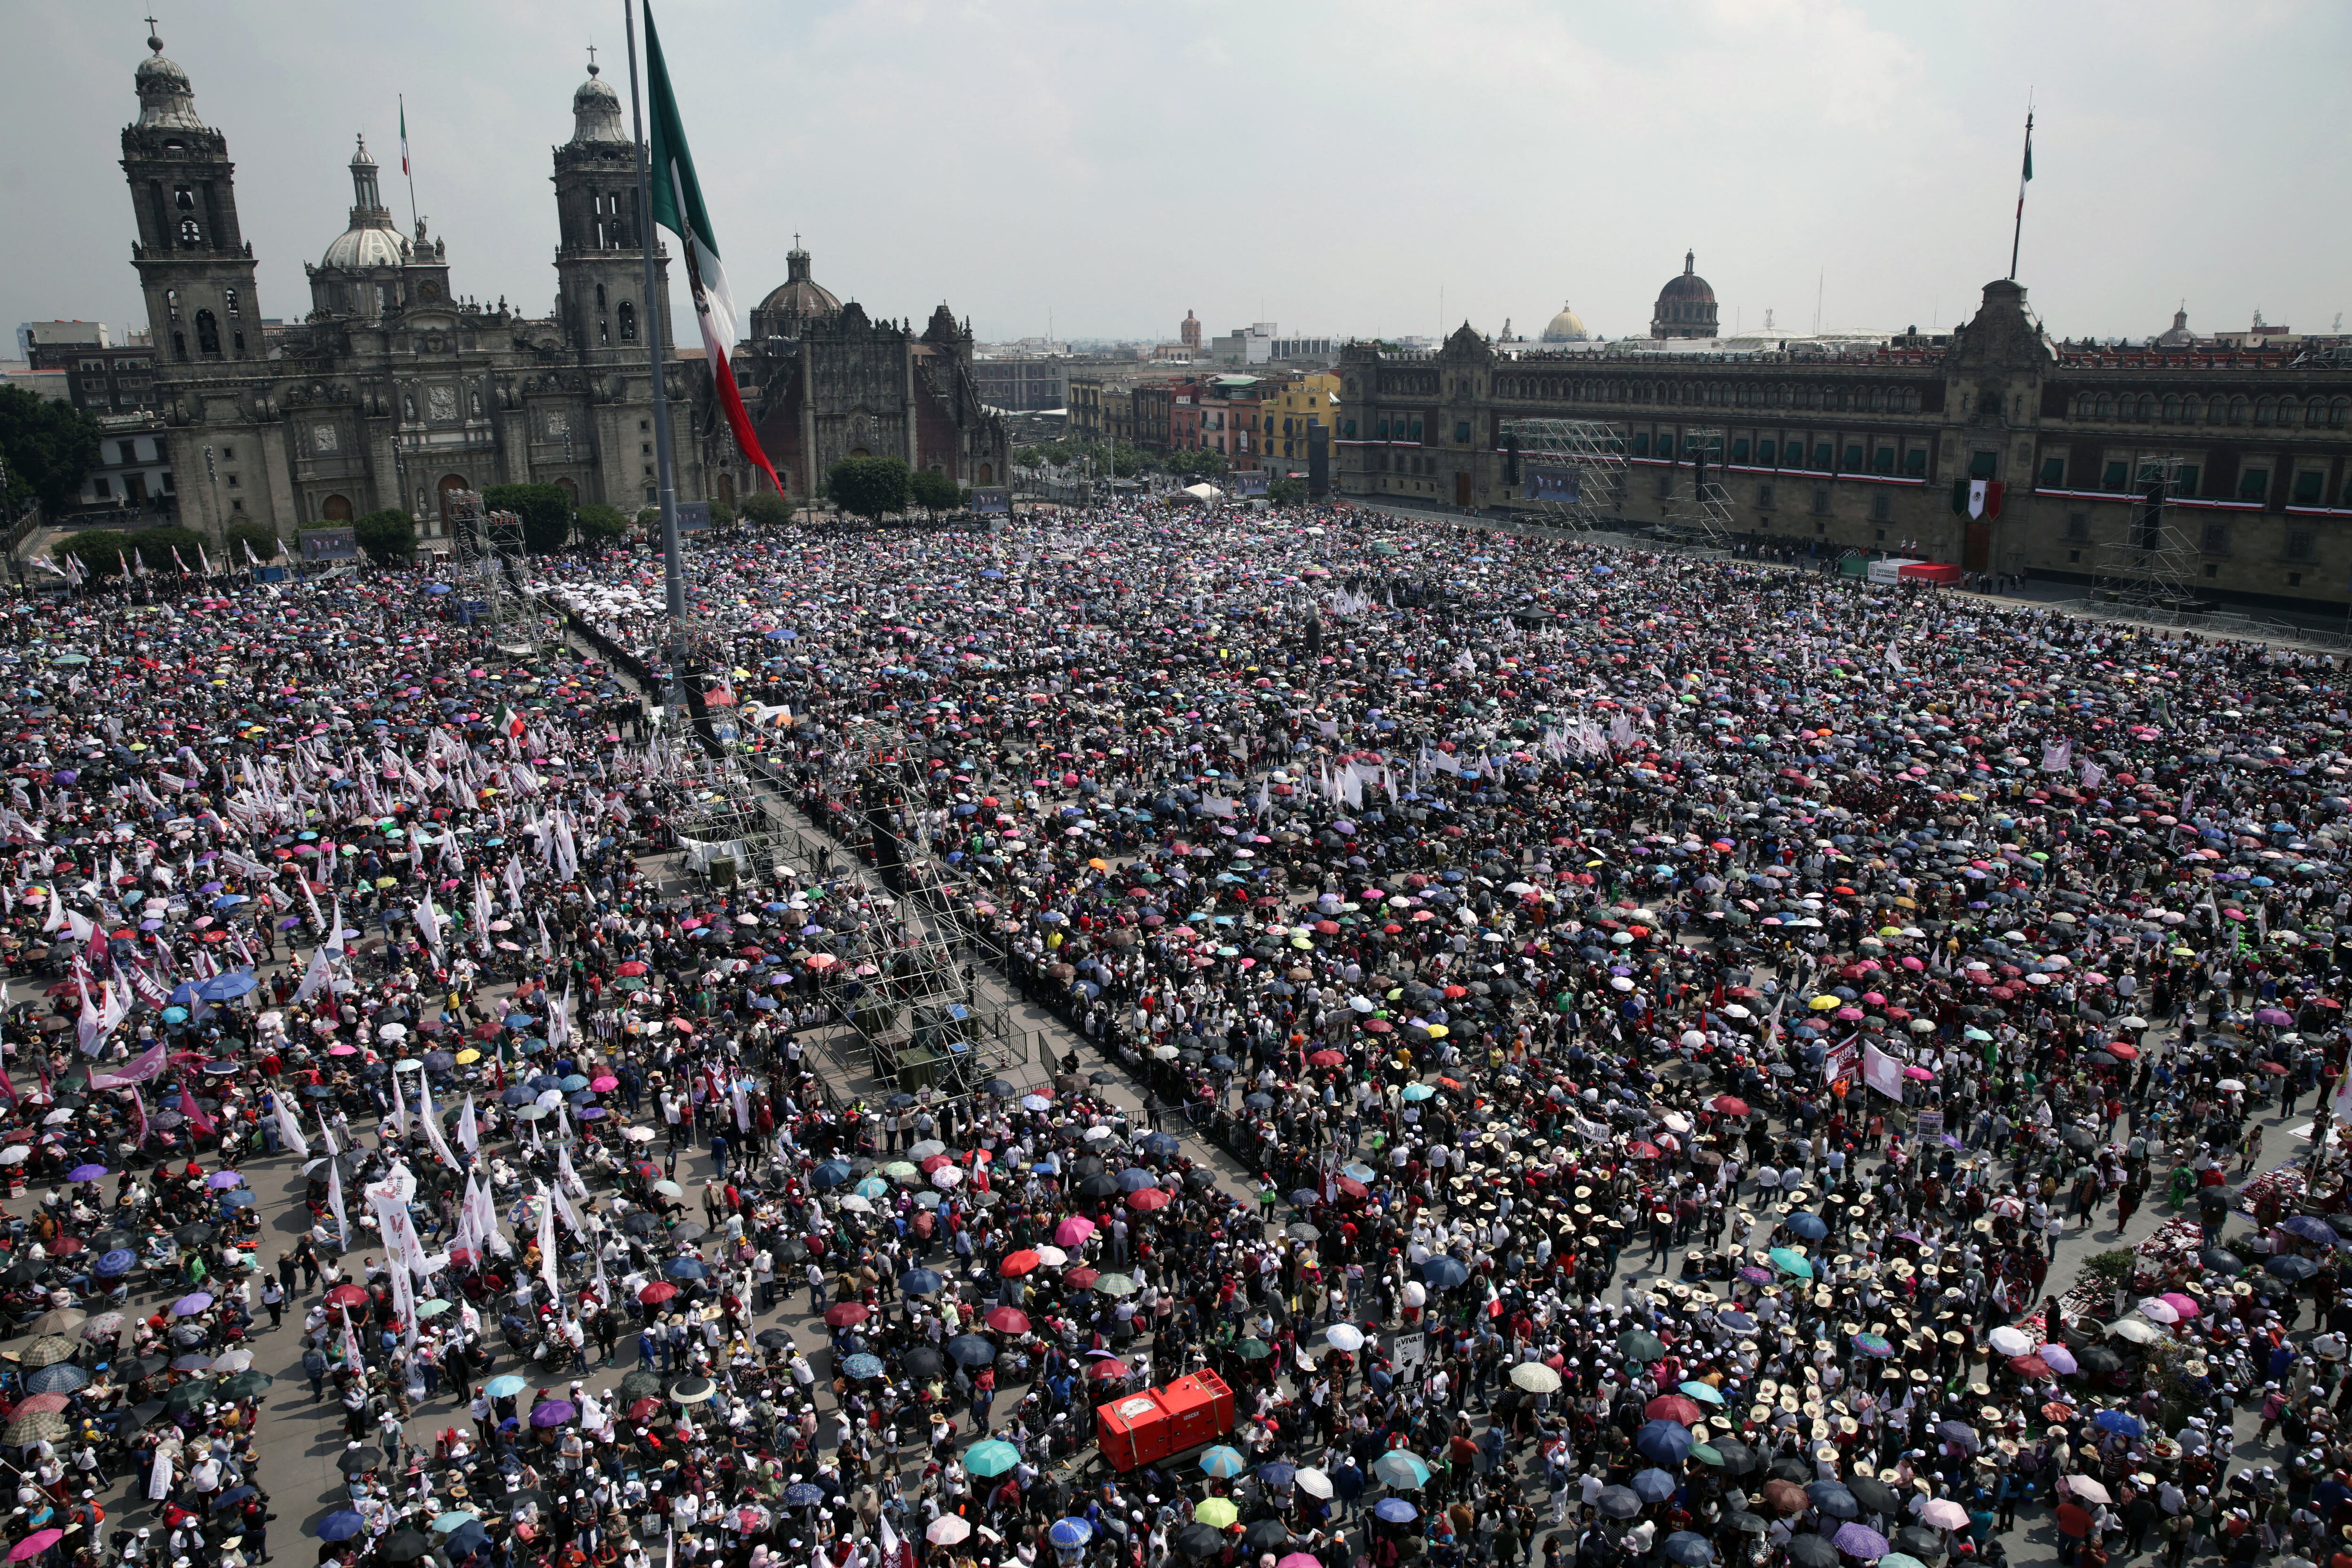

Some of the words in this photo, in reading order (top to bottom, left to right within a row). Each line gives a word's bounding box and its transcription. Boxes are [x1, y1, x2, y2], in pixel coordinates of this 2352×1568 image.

[271, 889, 289, 904] NECARLO
[129, 967, 168, 1004] SUMA
[1396, 1335, 1422, 1348] ¡¡VIVA!!
[799, 1359, 807, 1367] 17
[1393, 1380, 1421, 1392] AMLO
